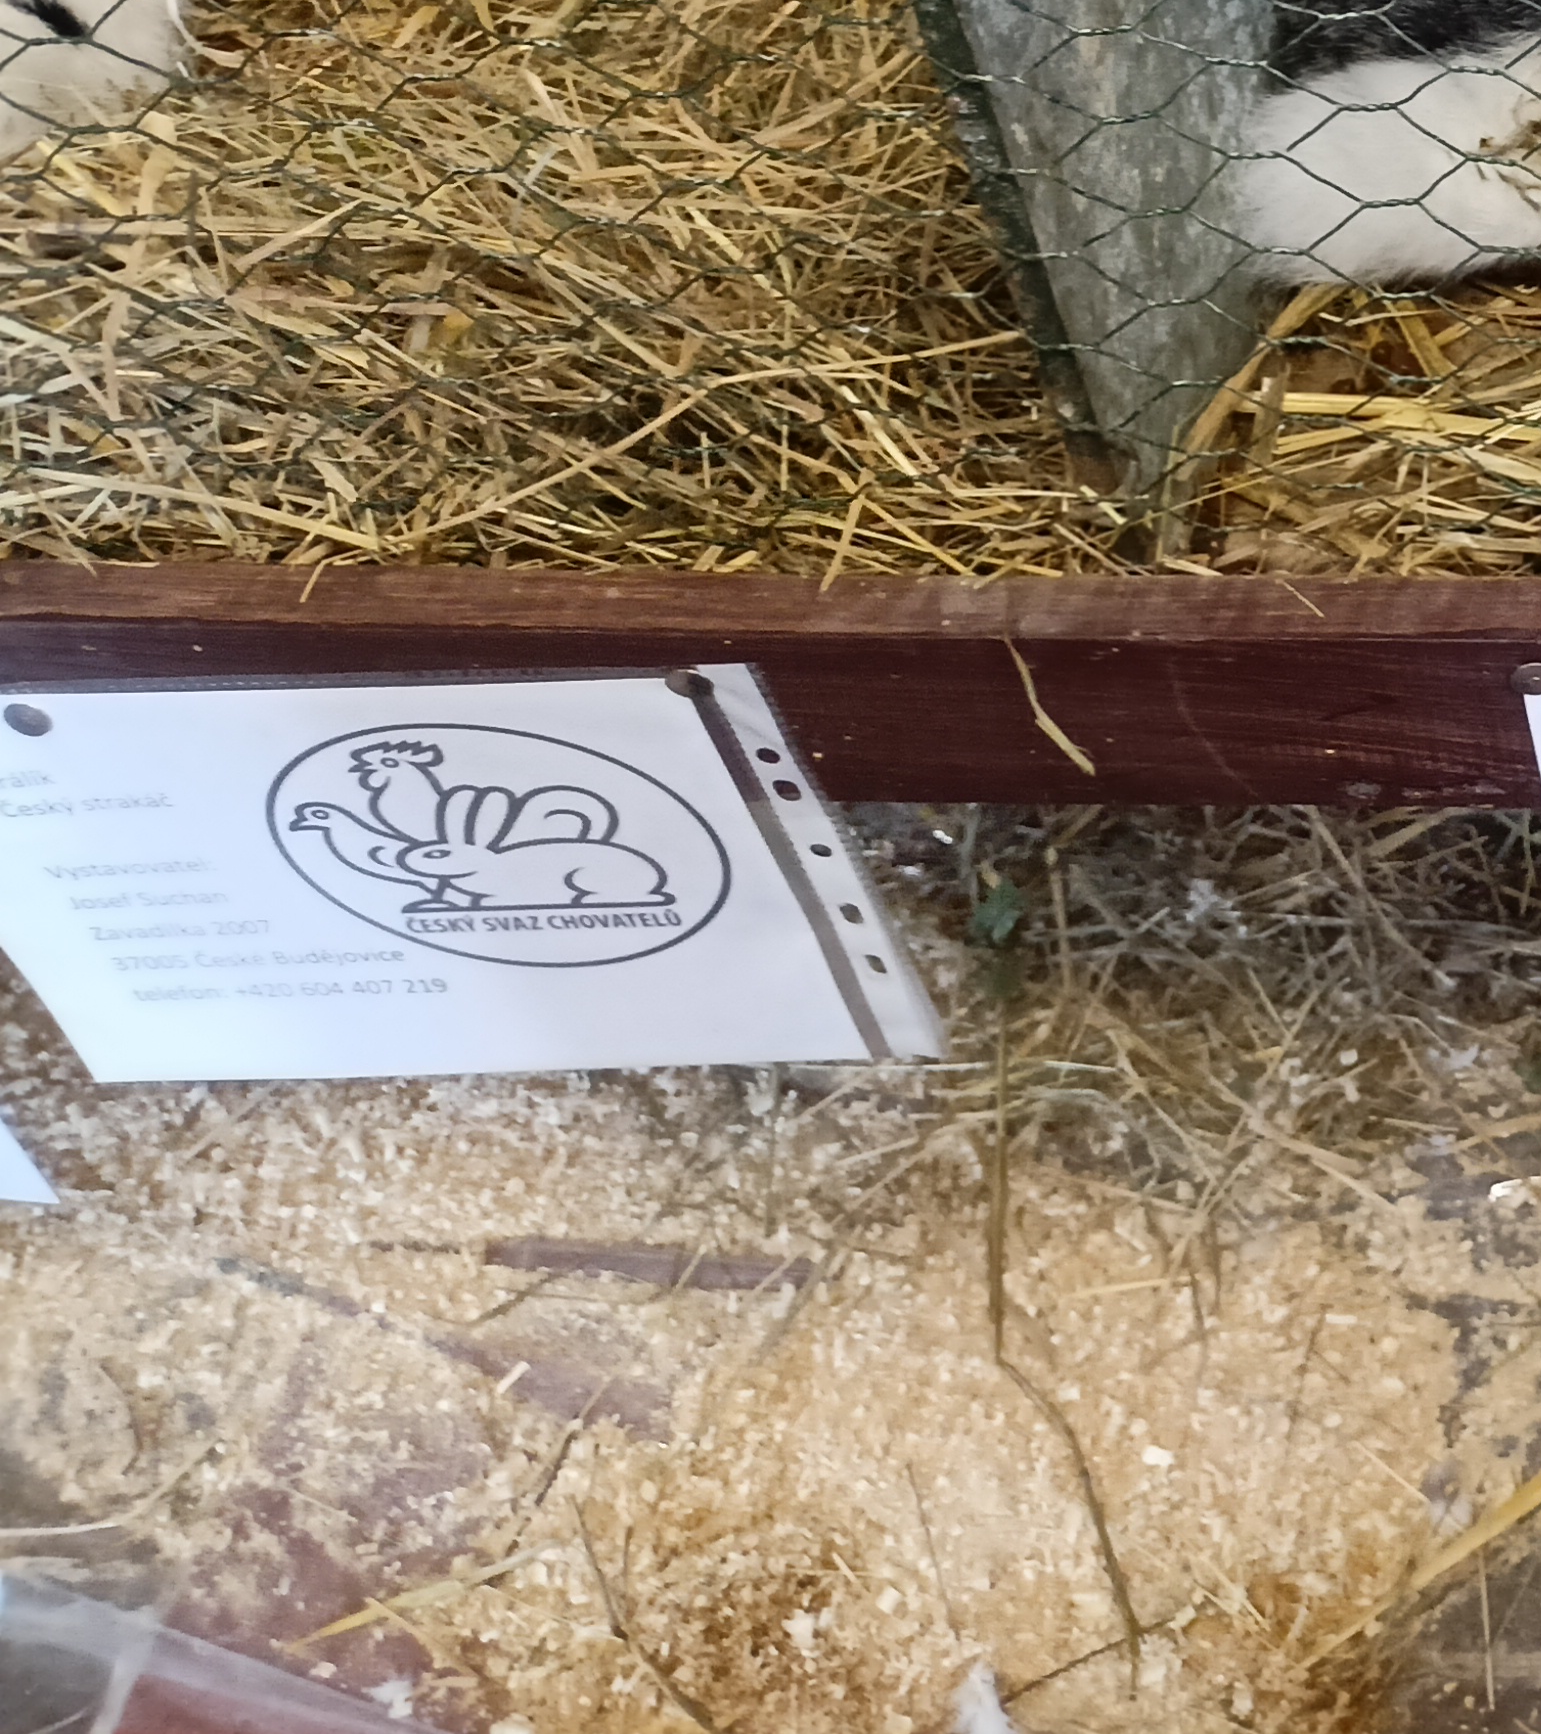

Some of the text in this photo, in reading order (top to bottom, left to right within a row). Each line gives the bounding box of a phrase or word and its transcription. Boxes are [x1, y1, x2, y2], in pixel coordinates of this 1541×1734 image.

[0, 770, 55, 788] rálík
[211, 919, 269, 936] 2007
[406, 909, 682, 934] ČESKÝ SVAZ CHOVATELŮ
[235, 981, 292, 998] +420
[301, 980, 344, 996] 604
[352, 979, 393, 995] 407
[402, 977, 447, 994] 219
